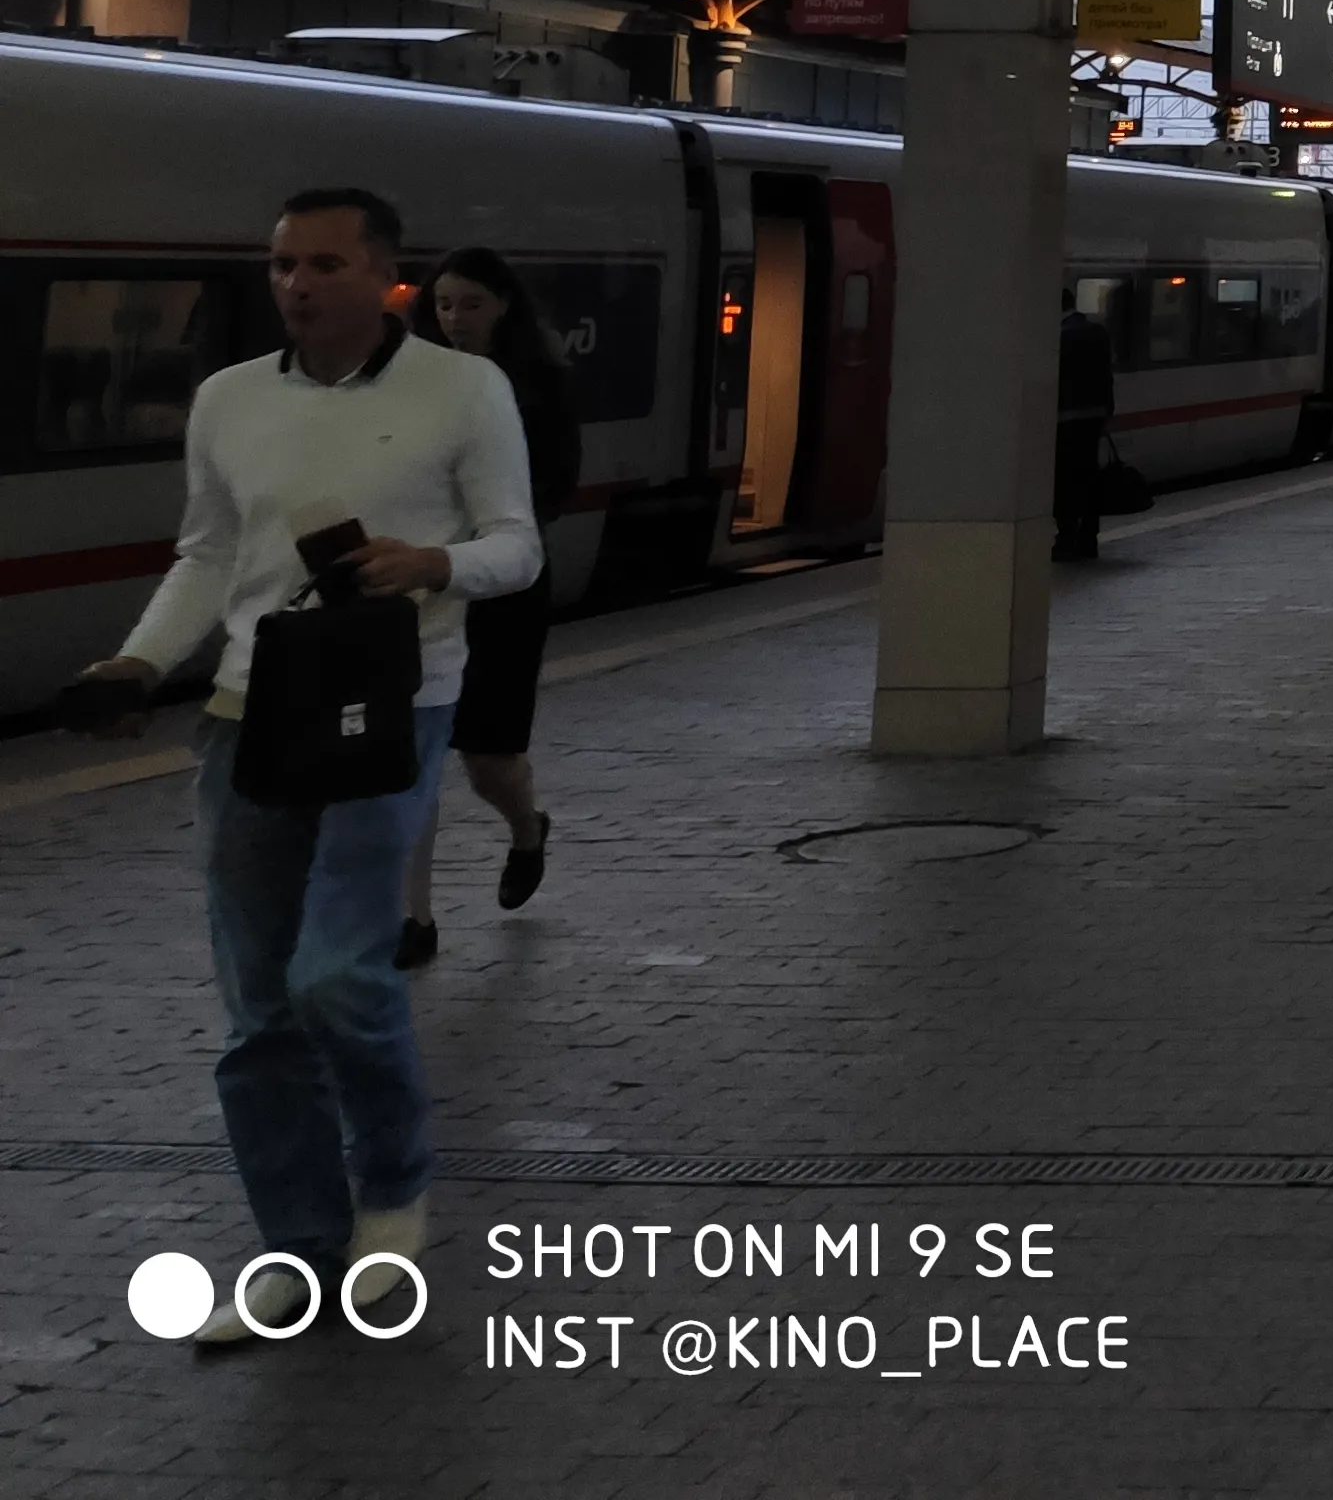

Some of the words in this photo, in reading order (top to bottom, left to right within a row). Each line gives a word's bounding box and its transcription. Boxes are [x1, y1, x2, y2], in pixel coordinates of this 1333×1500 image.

[1087, 2, 1127, 14] детей
[1130, 2, 1154, 15] без
[803, 13, 886, 27] запрещено!
[1088, 18, 1168, 31] присмотра!
